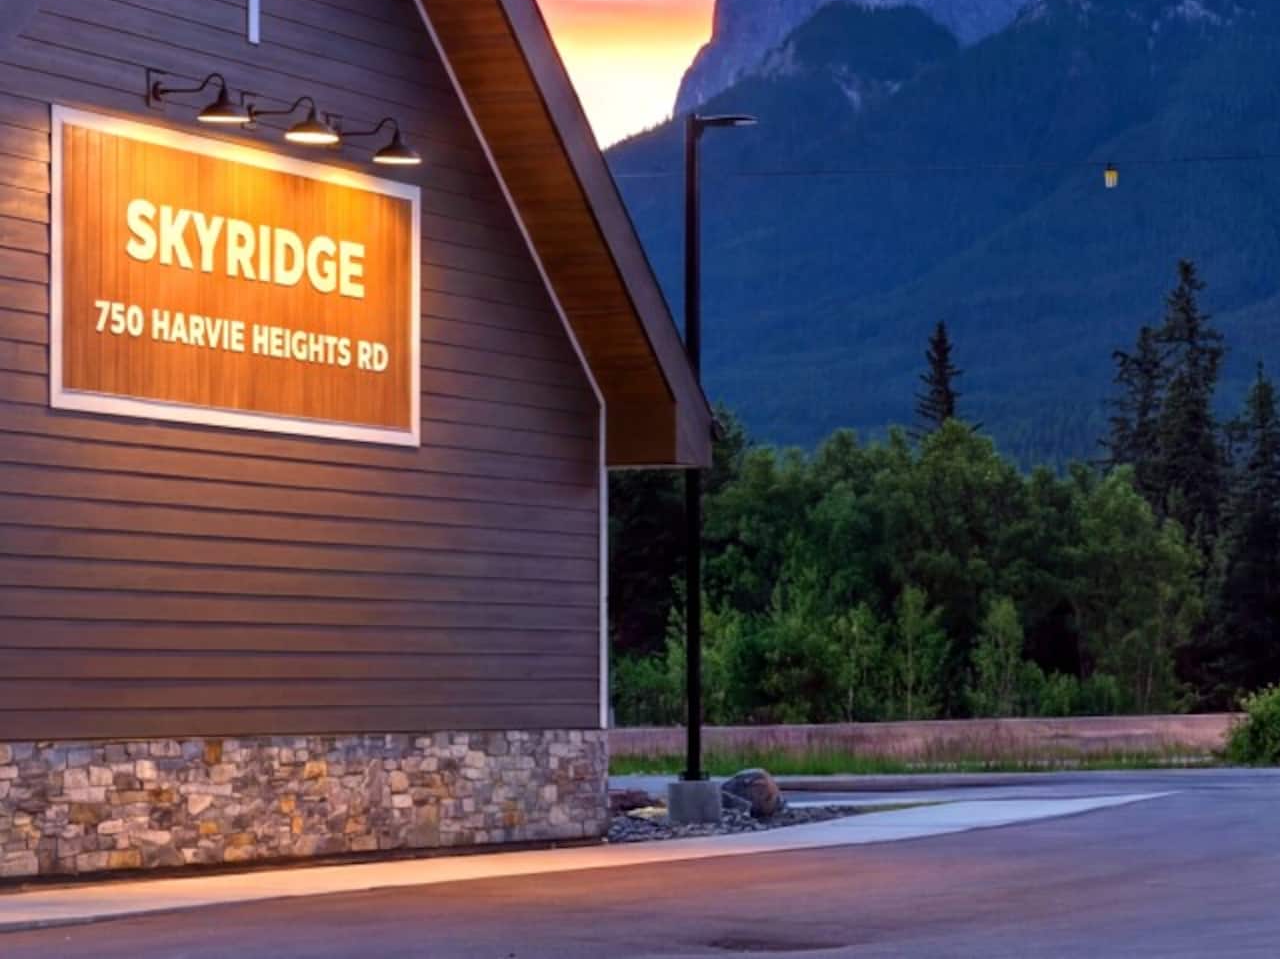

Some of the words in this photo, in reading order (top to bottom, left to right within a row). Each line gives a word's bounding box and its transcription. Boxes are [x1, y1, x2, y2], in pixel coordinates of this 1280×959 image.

[126, 199, 365, 297] SKYRIDGE
[94, 300, 144, 337] 750
[151, 309, 245, 352] HARVIE
[252, 324, 351, 366] HEIGHTS
[357, 340, 389, 372] RD
